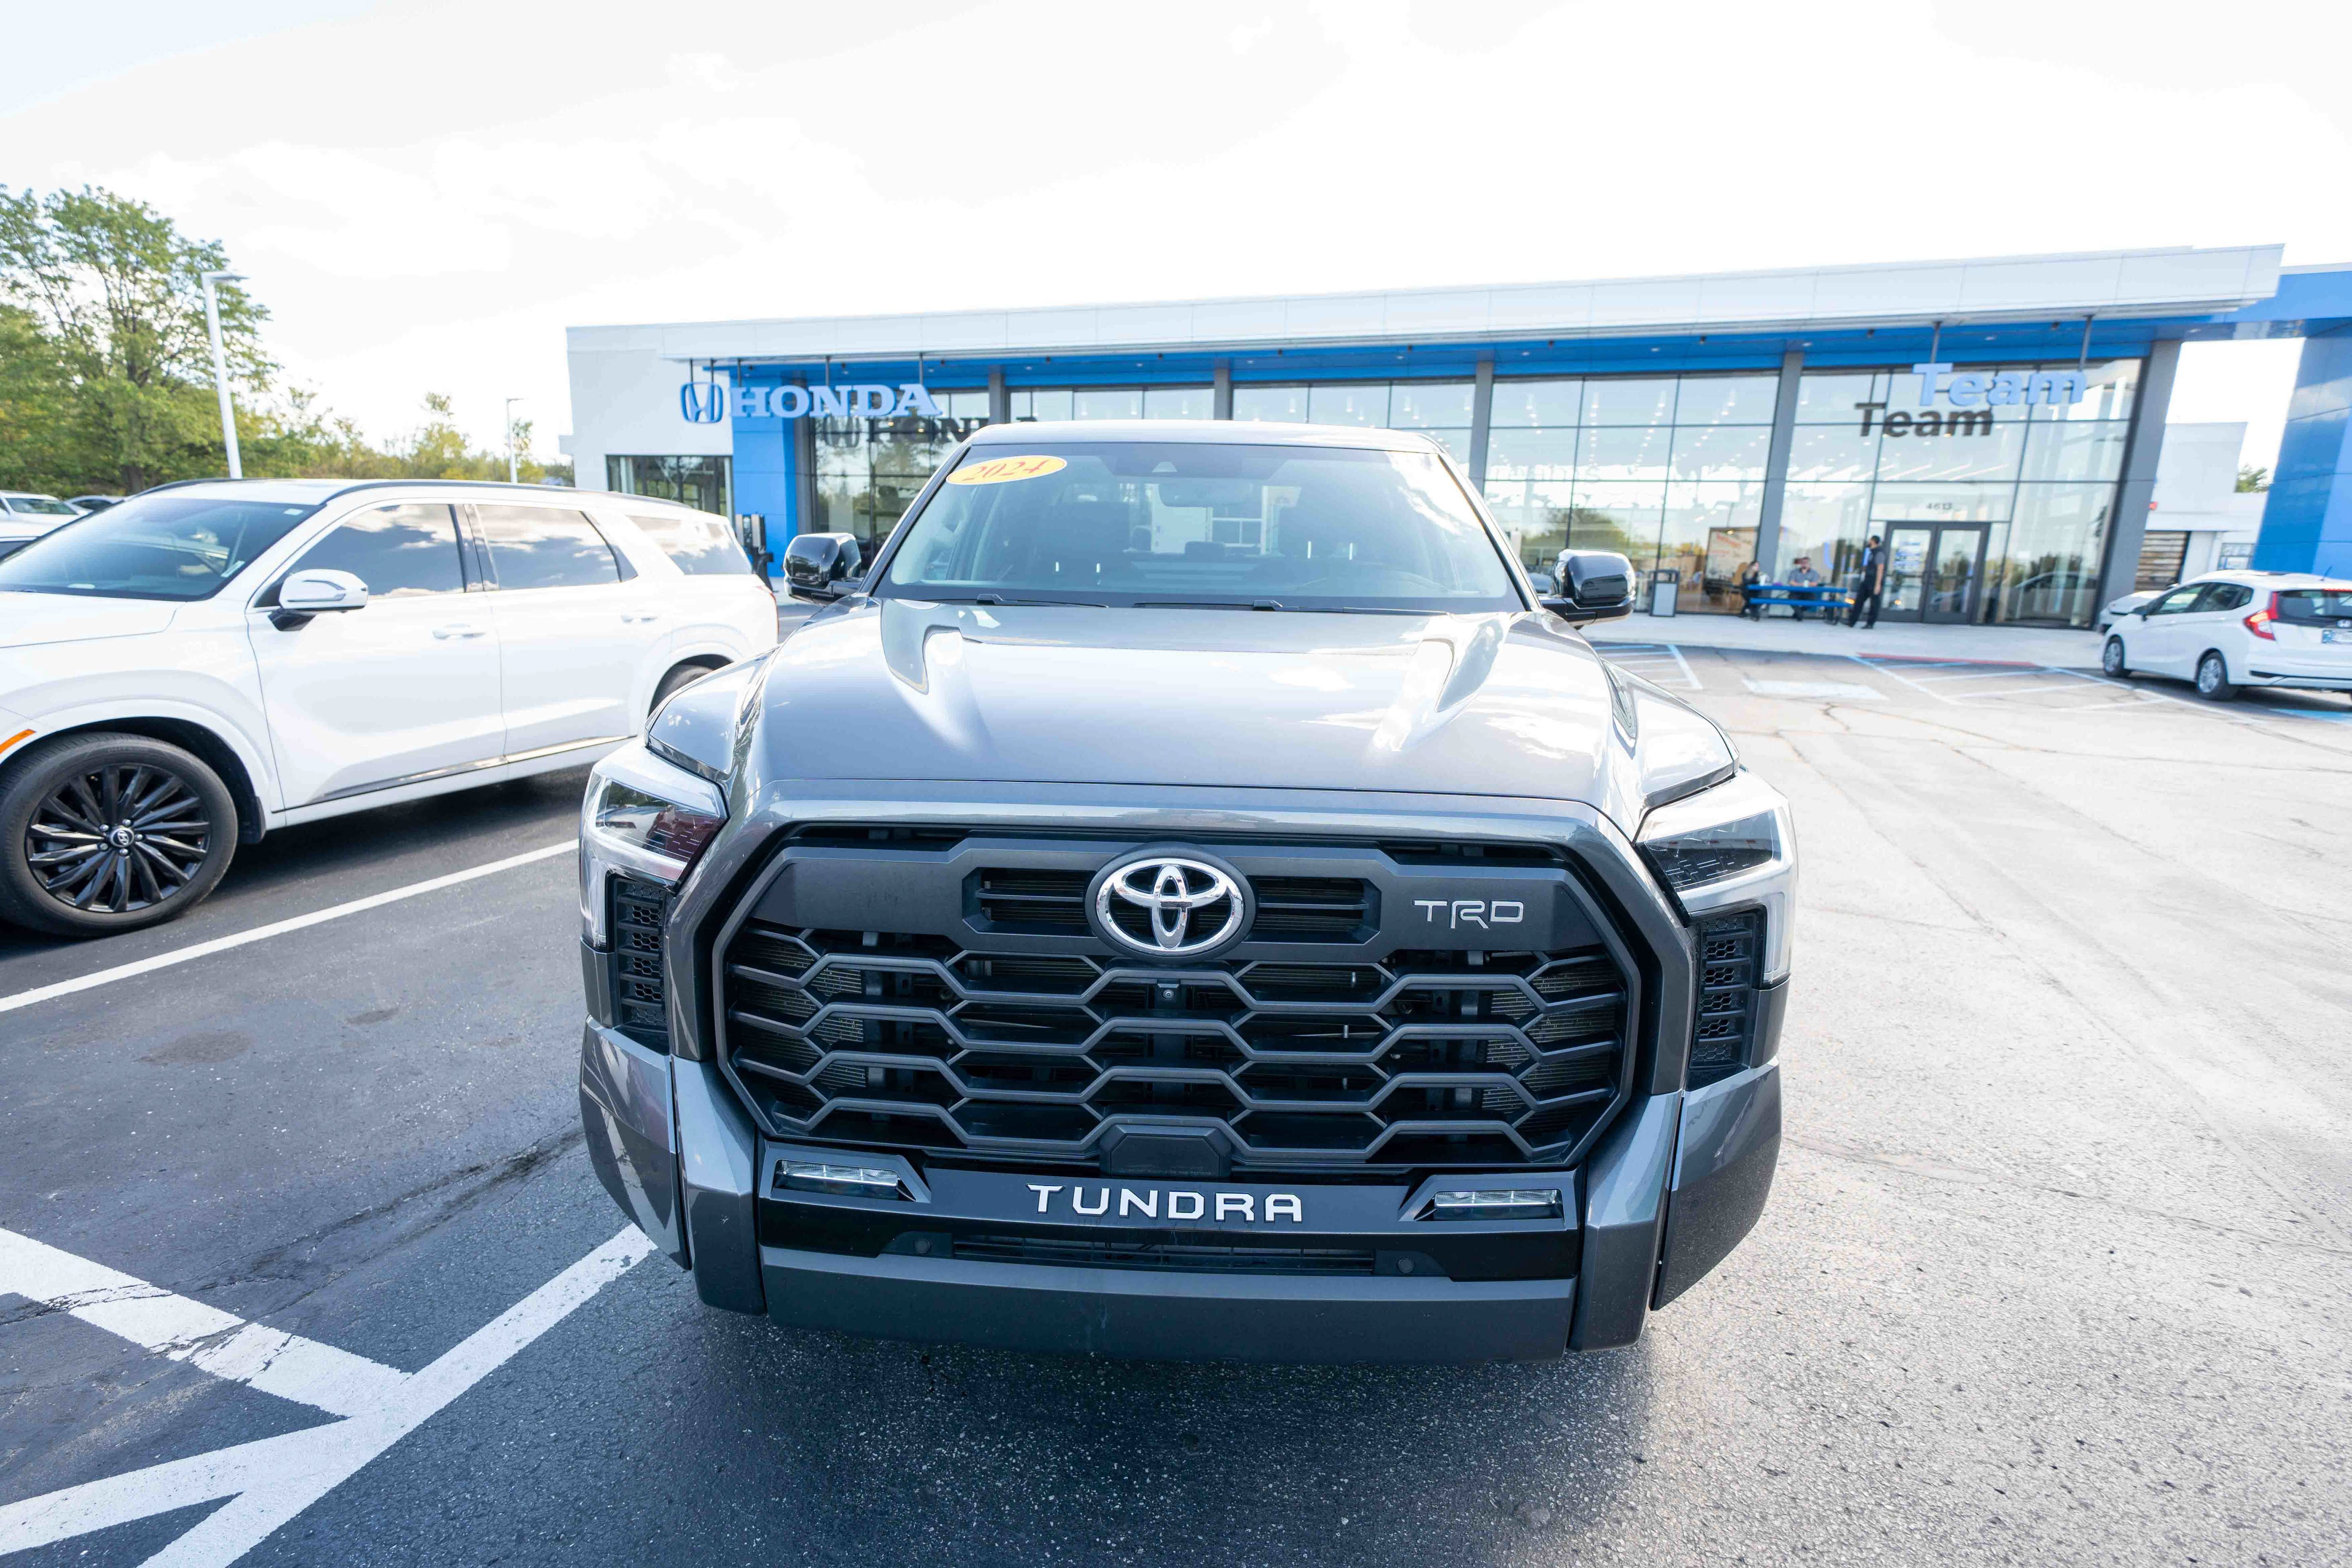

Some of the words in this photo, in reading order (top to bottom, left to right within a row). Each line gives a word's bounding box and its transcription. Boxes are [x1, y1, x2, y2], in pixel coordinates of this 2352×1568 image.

[730, 383, 943, 419] HONDA
[1912, 363, 2088, 406] Team
[1854, 403, 1993, 437] Team
[962, 459, 1050, 481] 2024
[1413, 900, 1524, 929] TRD
[1026, 1183, 1303, 1223] TUNDRA
